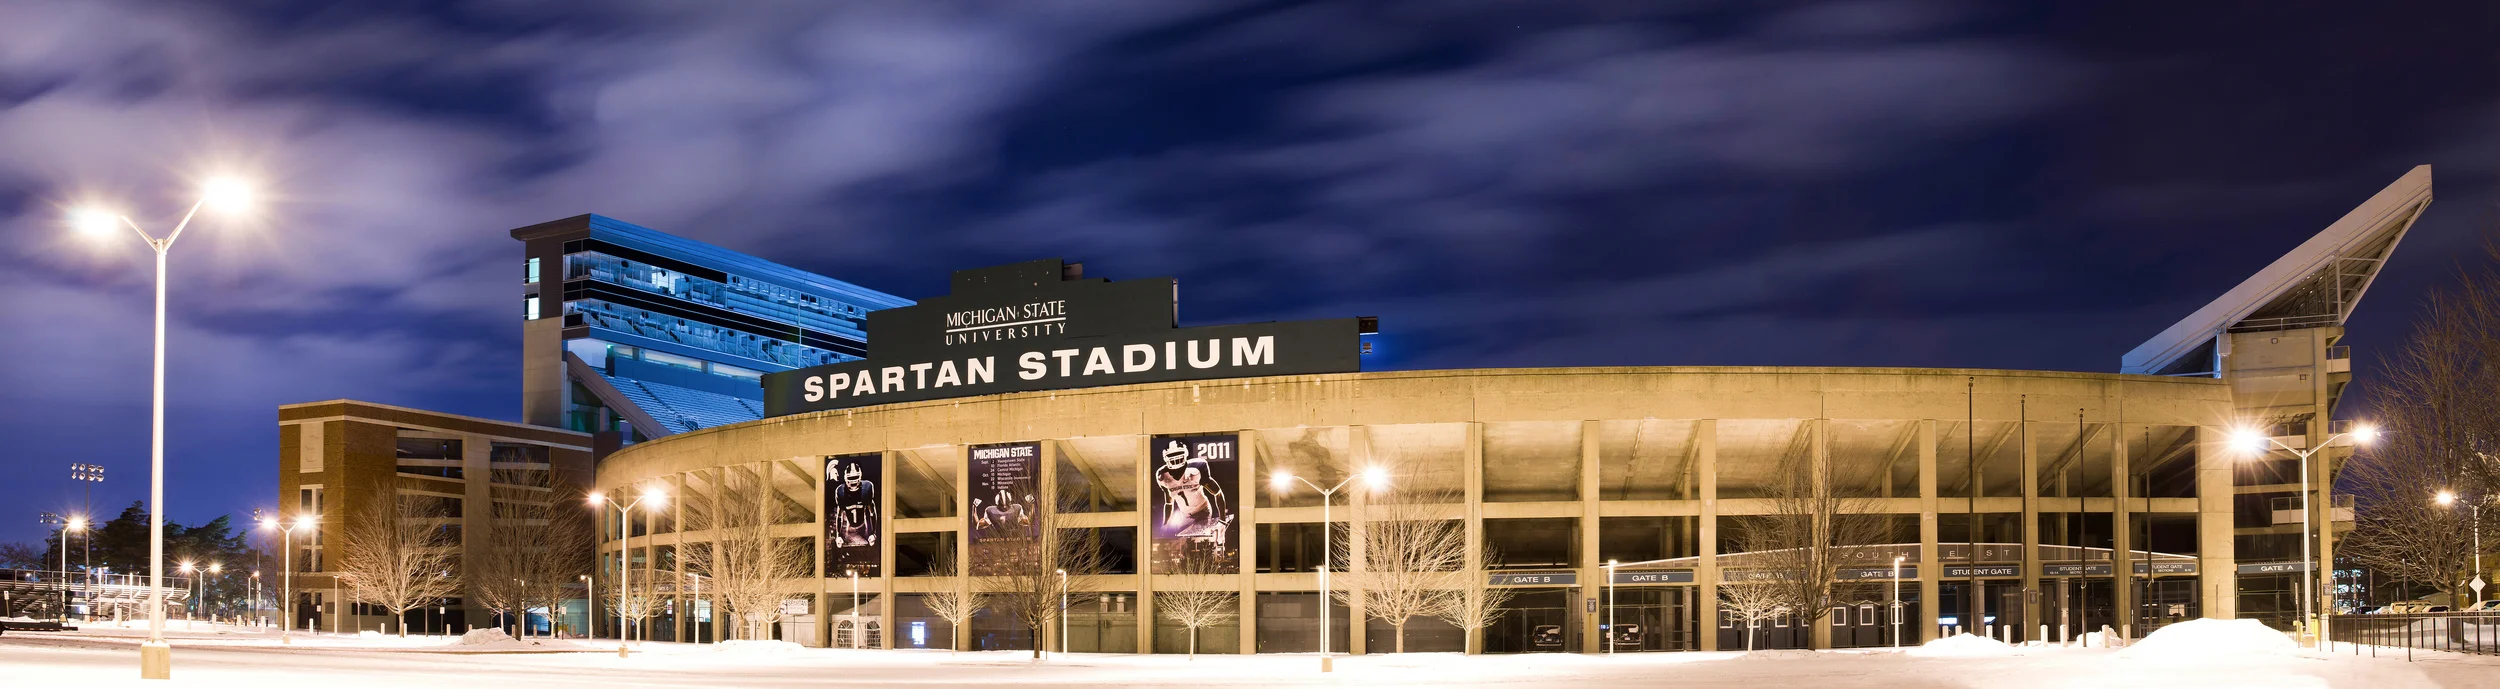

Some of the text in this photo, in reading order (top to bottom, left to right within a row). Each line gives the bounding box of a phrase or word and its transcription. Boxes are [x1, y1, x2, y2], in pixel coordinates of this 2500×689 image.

[946, 300, 1066, 328] MICHIGAN STATE
[945, 322, 1066, 346] UNIVERSITY
[804, 335, 1275, 402] SPARTAN STADIUM
[974, 446, 1033, 460] MICHIGAN STATE
[1198, 442, 1230, 460] 2011
[851, 509, 857, 524] 1
[1949, 549, 2010, 557] EST
